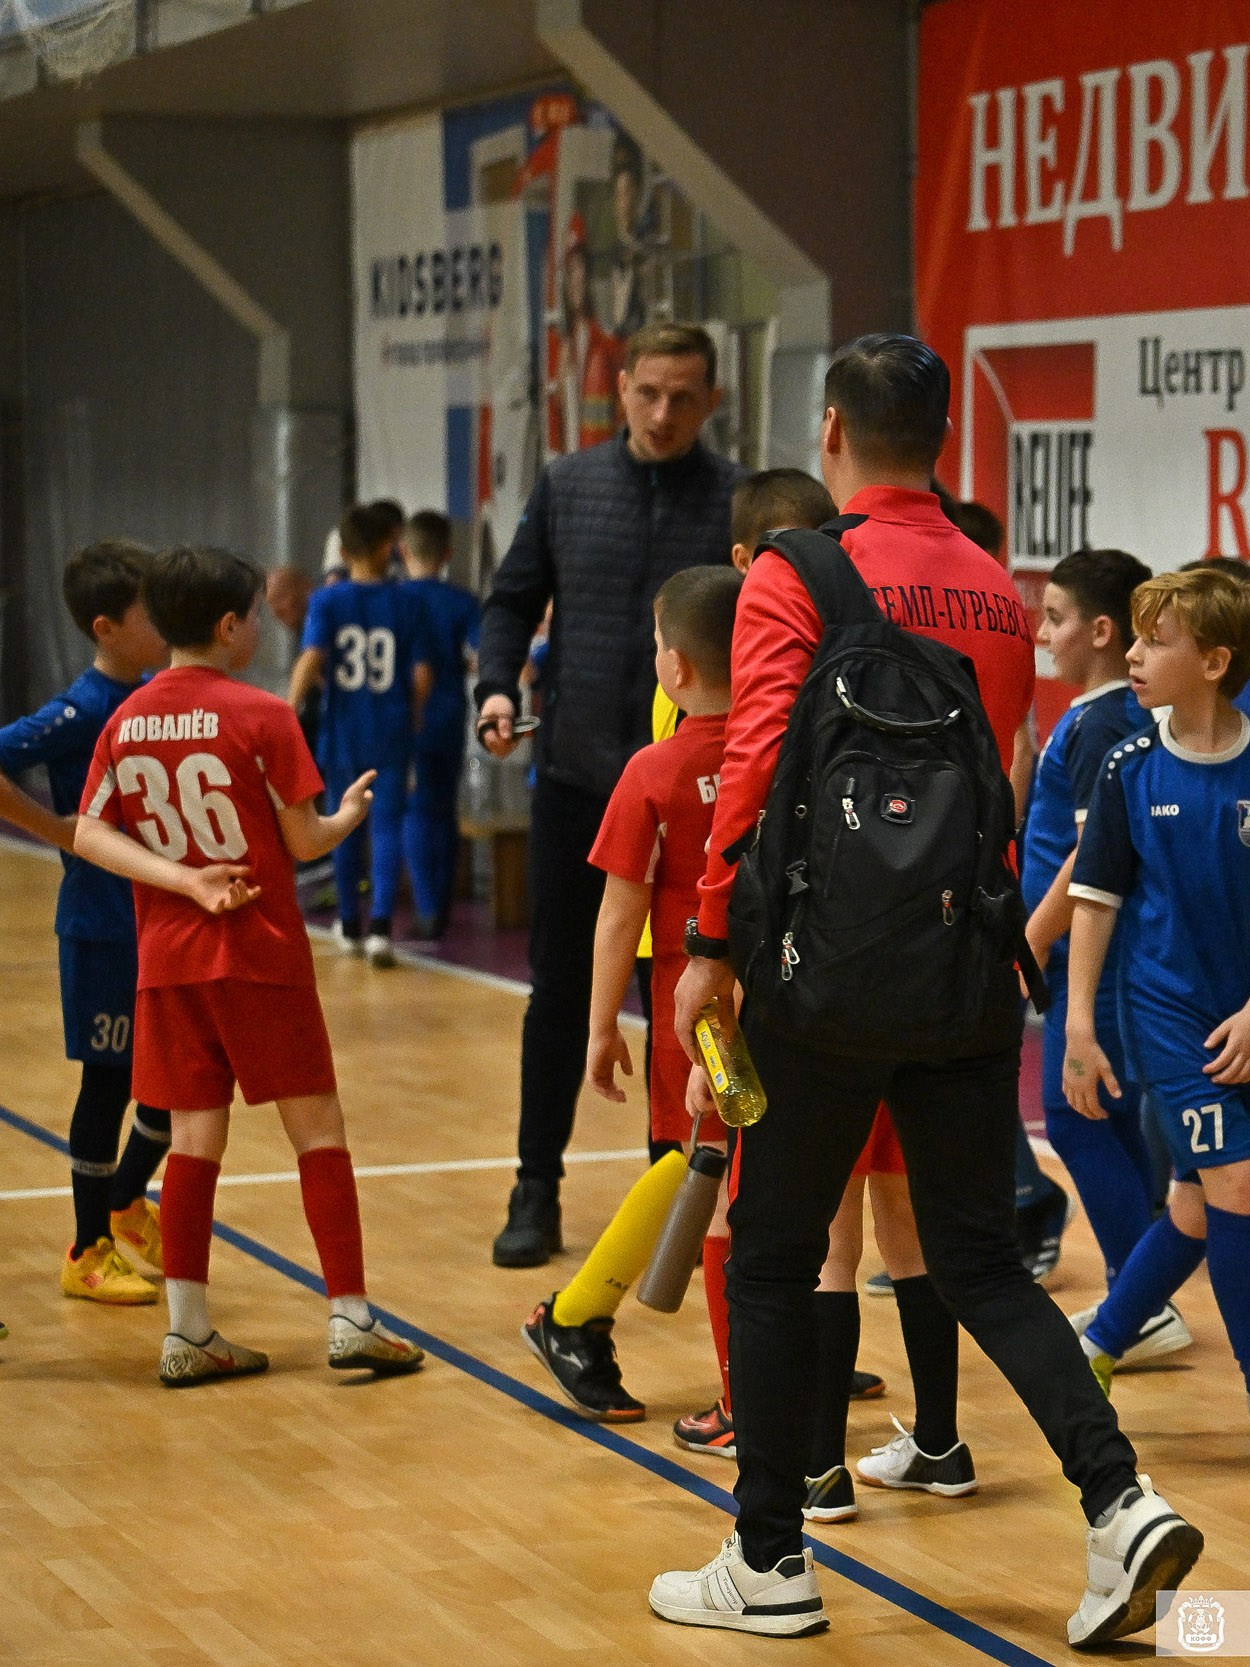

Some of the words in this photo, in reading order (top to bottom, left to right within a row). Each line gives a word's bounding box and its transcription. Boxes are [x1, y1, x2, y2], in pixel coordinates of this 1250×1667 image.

[371, 241, 502, 319] KIDSBERG
[1138, 336, 1246, 411] Центр
[335, 624, 396, 693] 39
[118, 709, 219, 744] КОВАЛЁВ
[116, 752, 249, 862] 36
[91, 1013, 130, 1052] 30
[1181, 1103, 1224, 1153] 27
